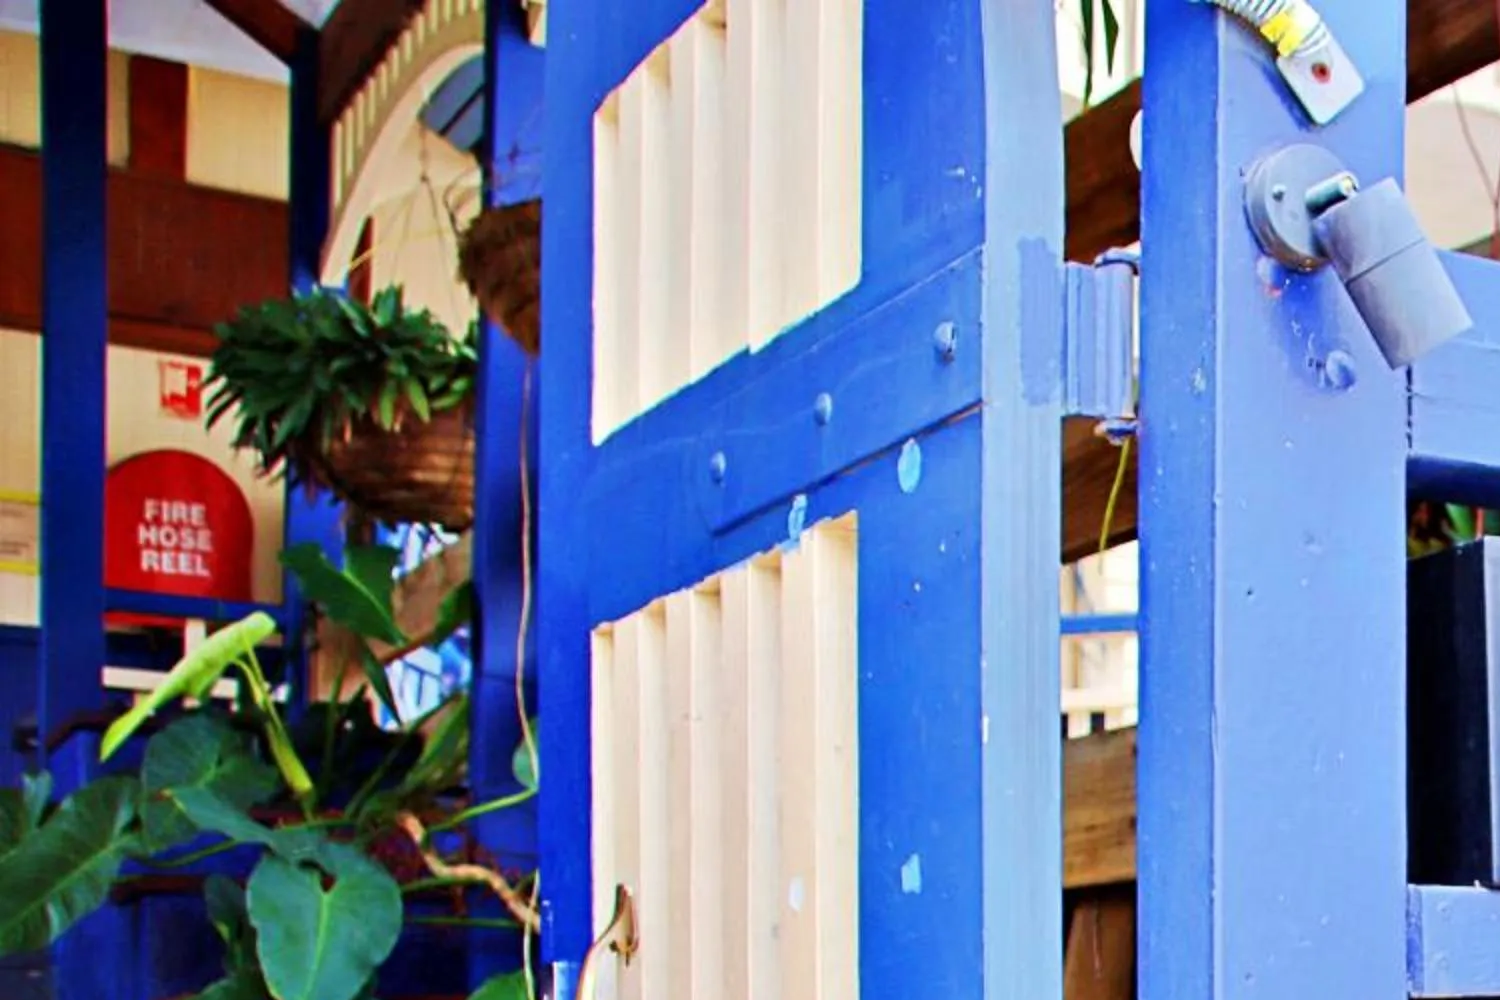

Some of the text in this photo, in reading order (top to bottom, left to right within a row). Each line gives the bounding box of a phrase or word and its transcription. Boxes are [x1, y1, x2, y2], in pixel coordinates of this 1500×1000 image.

[144, 498, 206, 526] FIRE
[138, 524, 213, 551] HOSE
[141, 549, 210, 577] REEL
